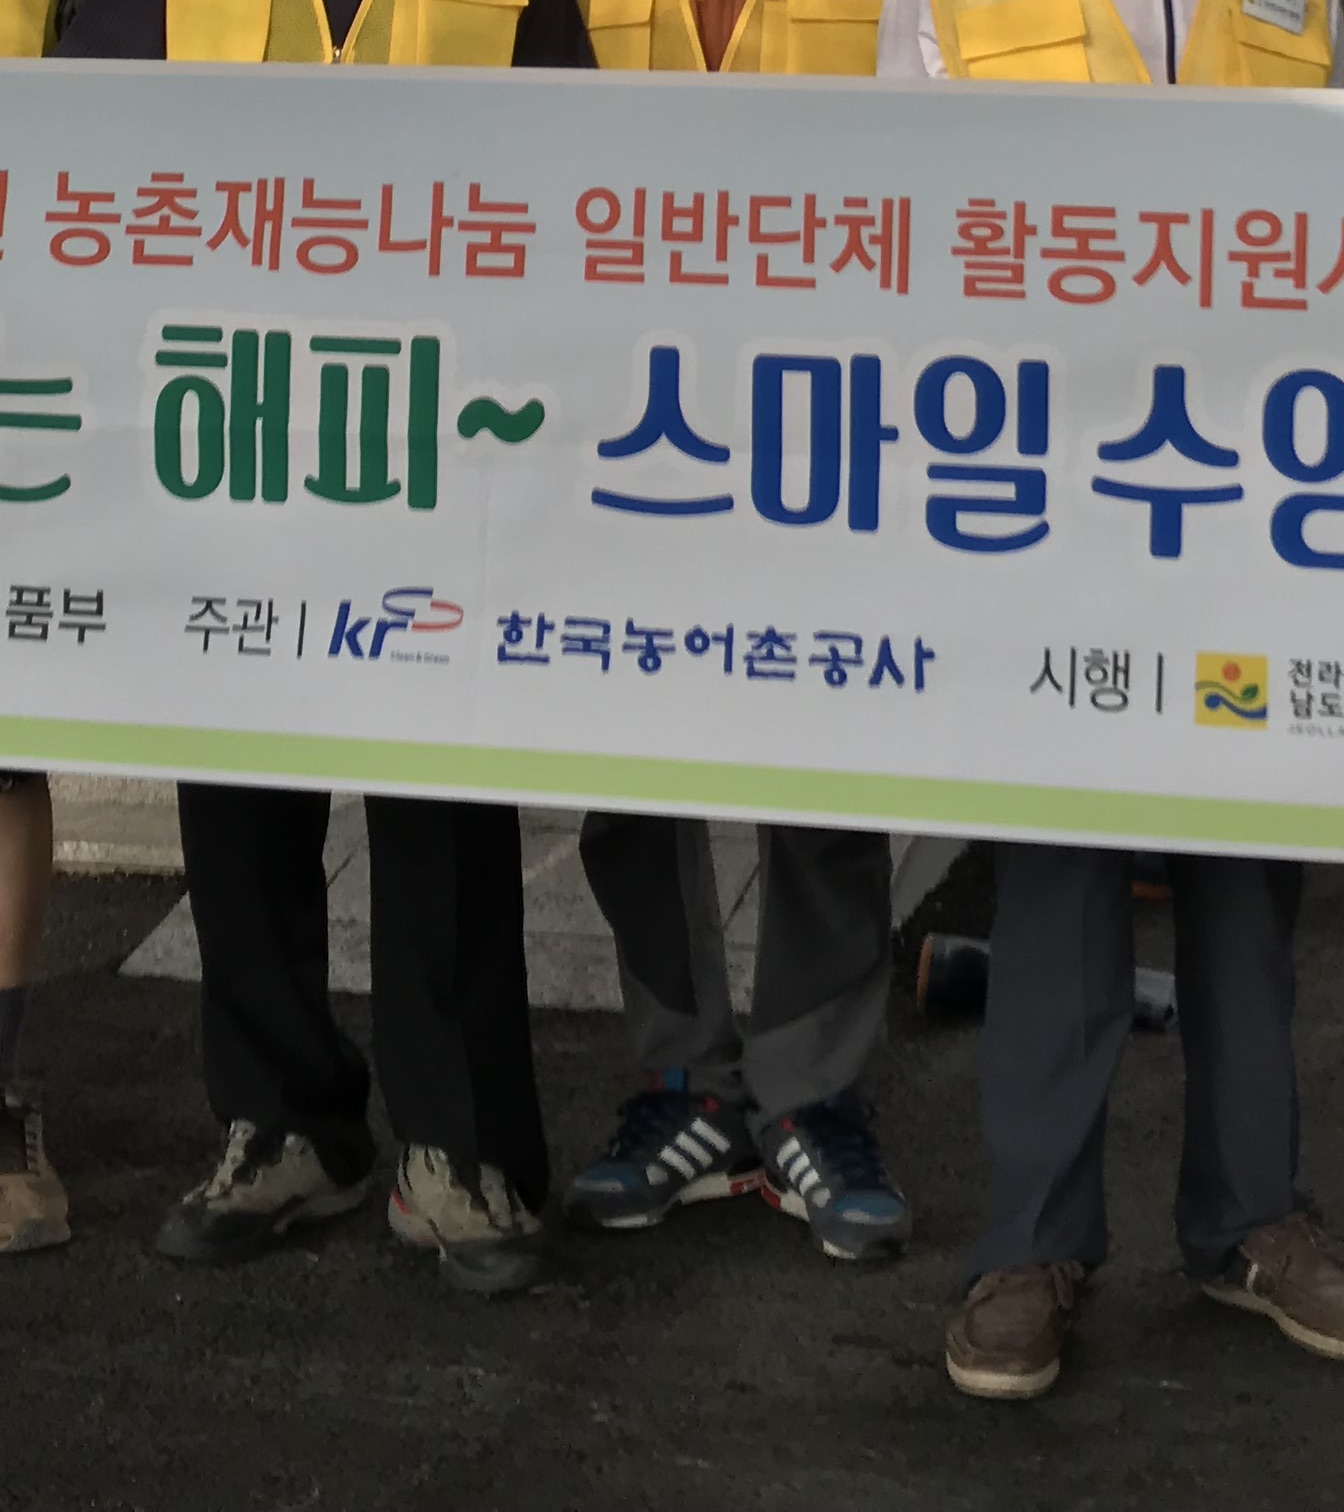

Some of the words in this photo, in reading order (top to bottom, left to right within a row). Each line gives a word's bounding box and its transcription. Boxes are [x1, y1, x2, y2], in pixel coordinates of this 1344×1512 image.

[46, 172, 537, 280] 농촌재능나눔
[577, 187, 913, 296] 일반단체
[154, 324, 546, 512] 해피~
[185, 597, 281, 657] 주관
[497, 611, 937, 695] 한국농어촌공사
[1030, 647, 1132, 714] 시행
